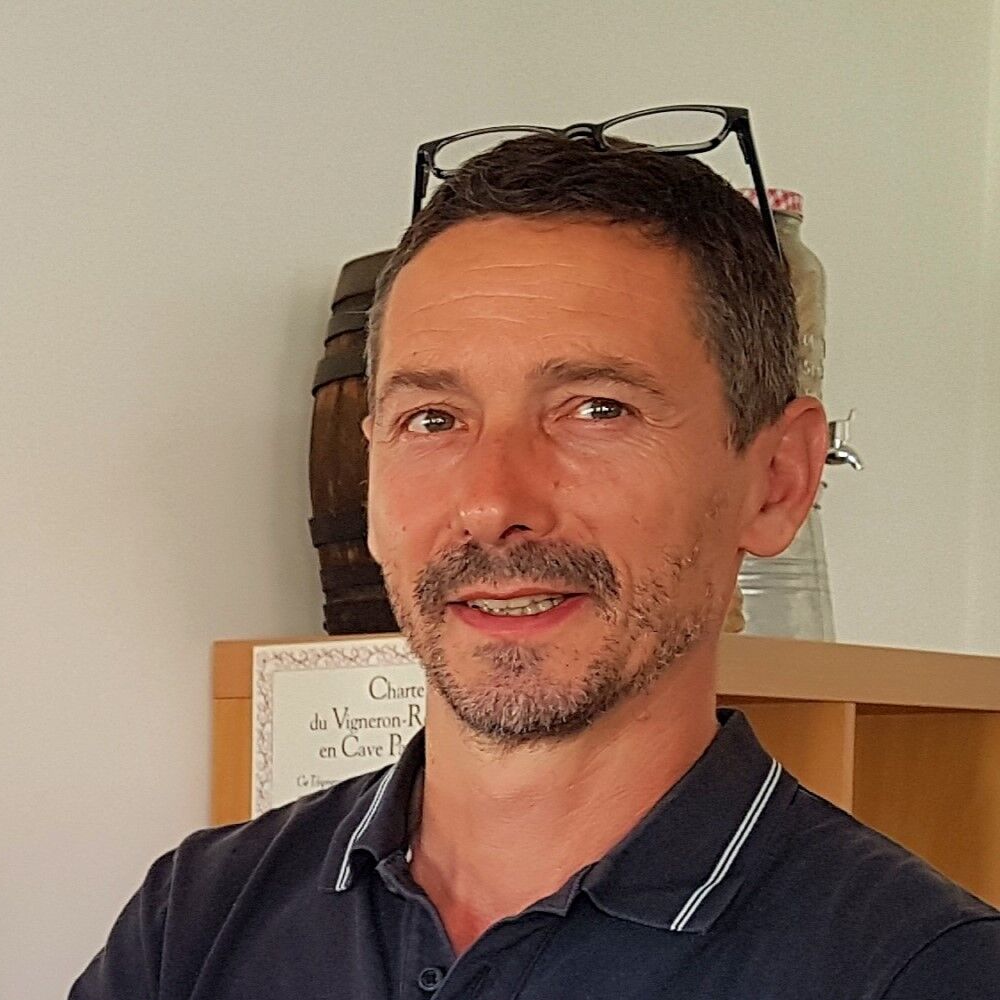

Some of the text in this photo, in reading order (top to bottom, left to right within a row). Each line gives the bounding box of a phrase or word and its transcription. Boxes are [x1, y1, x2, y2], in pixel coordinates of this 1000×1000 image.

[369, 675, 425, 700] Charte
[310, 713, 328, 731] du
[319, 746, 336, 758] en
[341, 735, 383, 758] Cave
